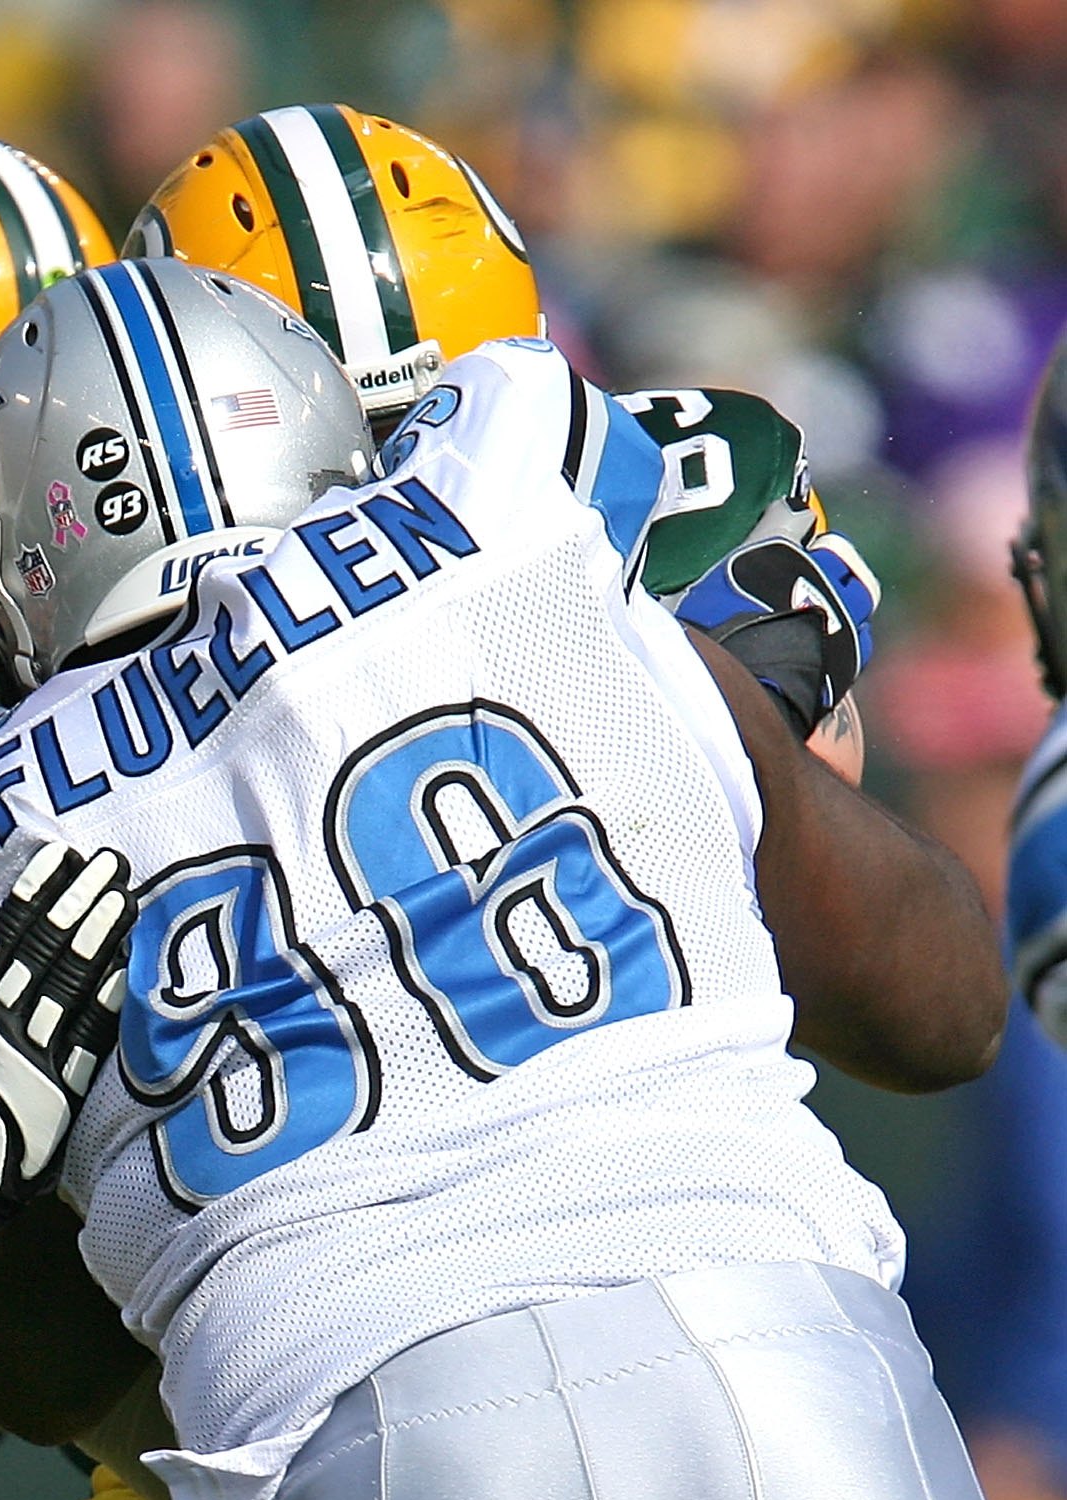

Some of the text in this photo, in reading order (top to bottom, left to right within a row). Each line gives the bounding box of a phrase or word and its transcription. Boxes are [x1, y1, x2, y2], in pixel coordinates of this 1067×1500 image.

[355, 363, 414, 390] ddell
[82, 436, 125, 472] RS
[103, 489, 142, 526] 93
